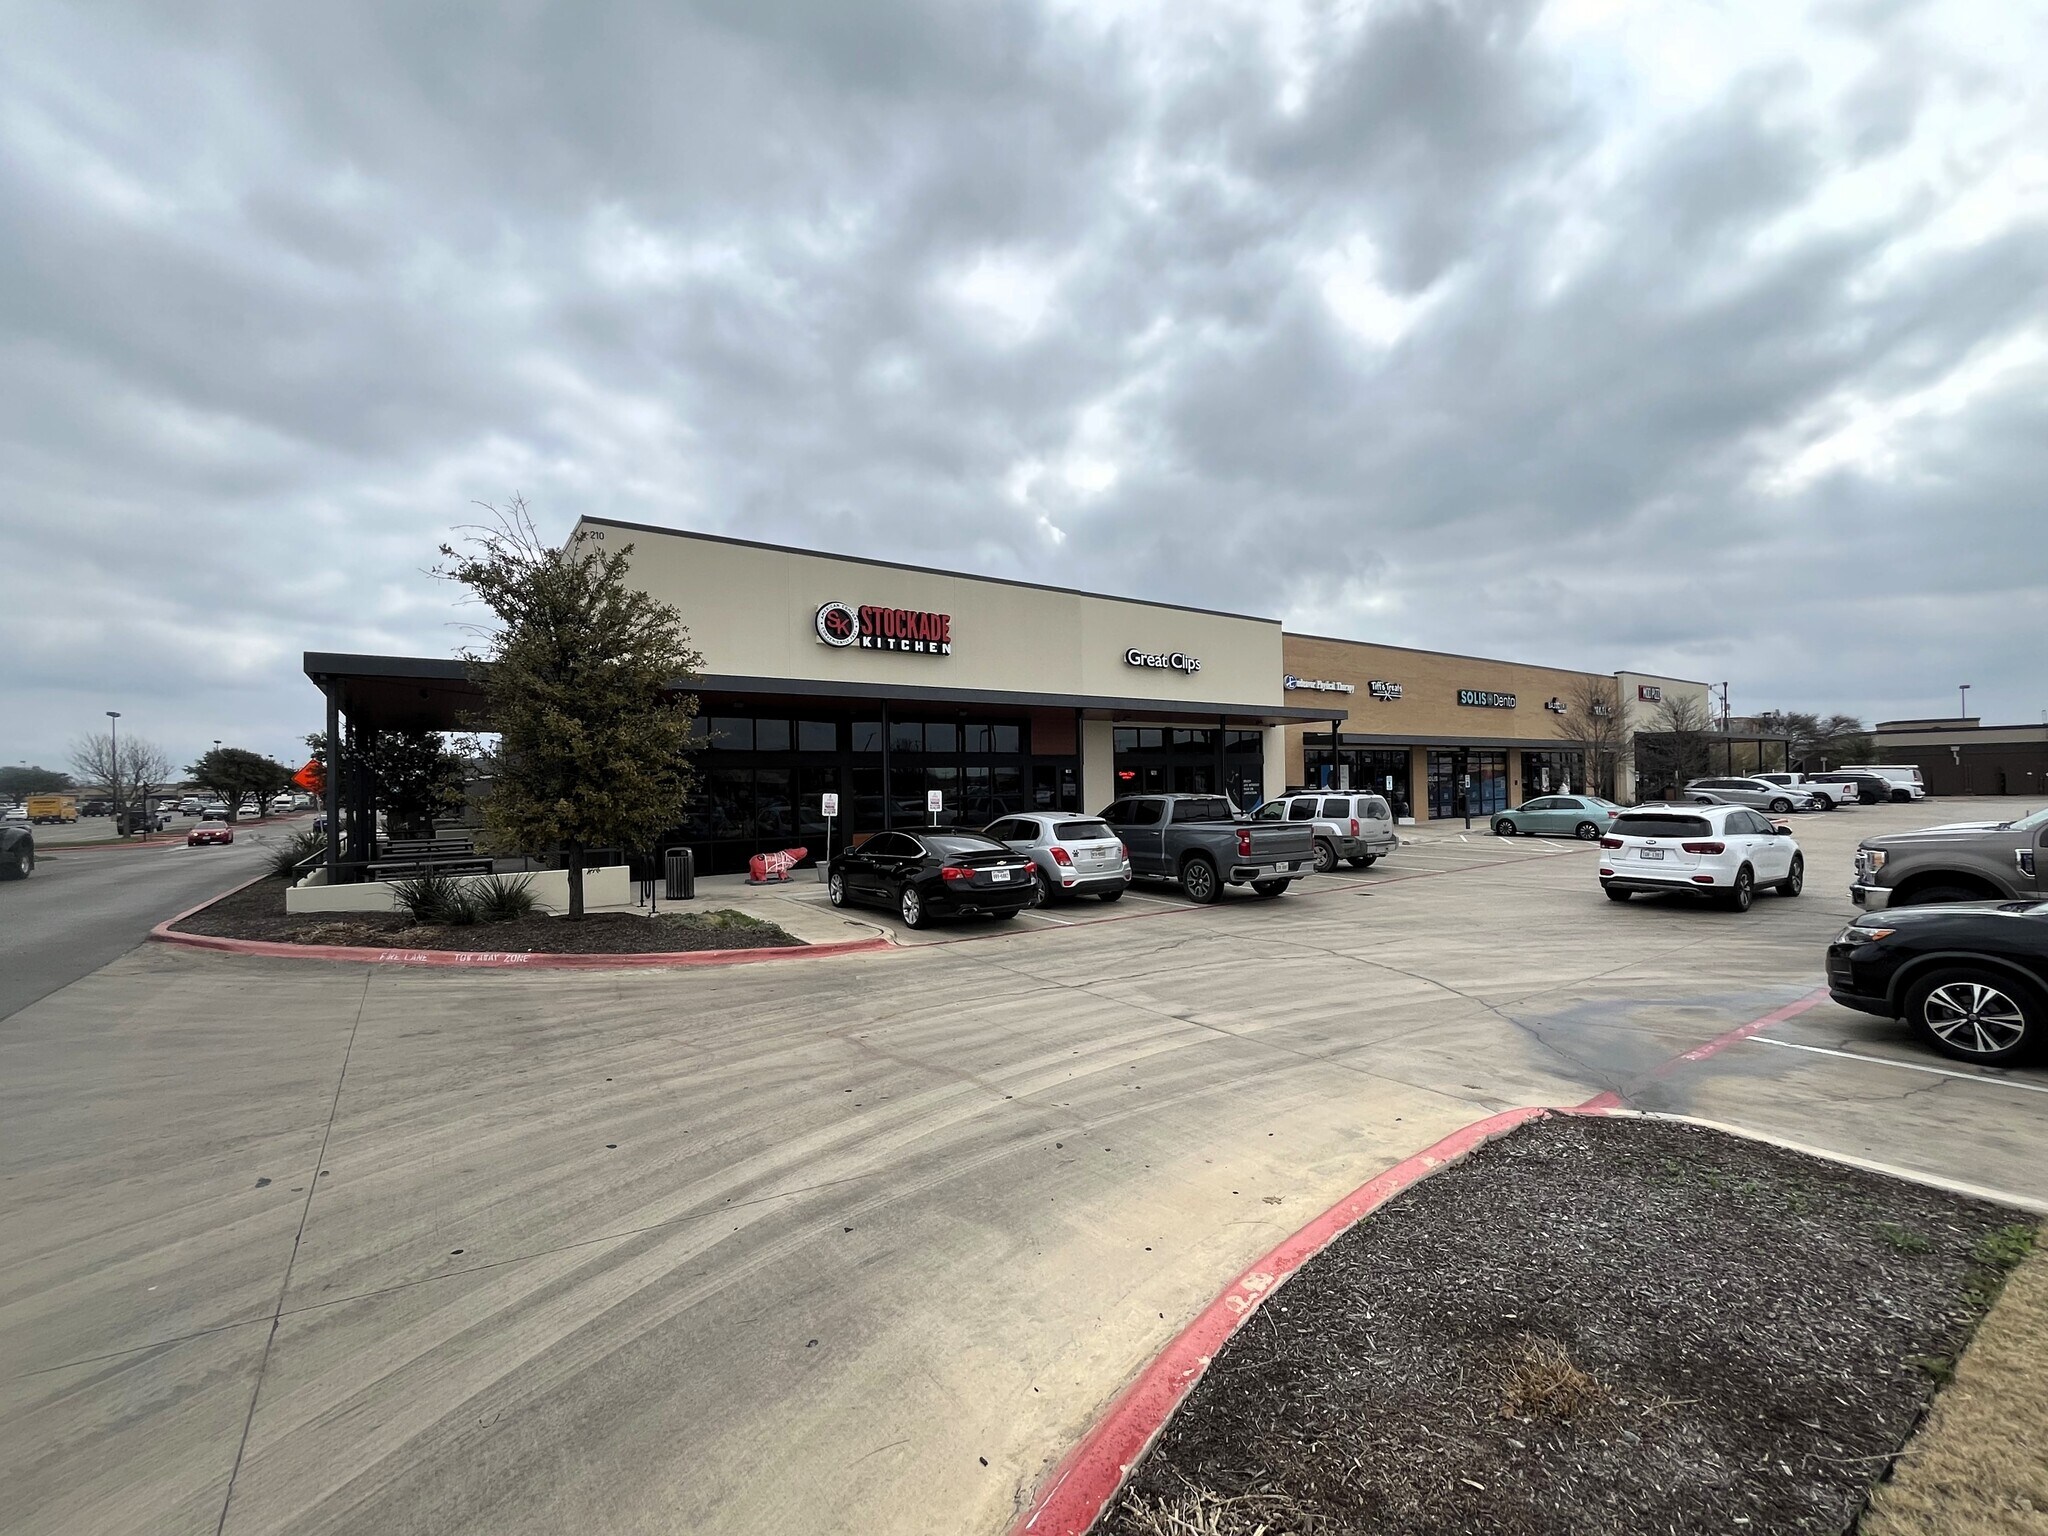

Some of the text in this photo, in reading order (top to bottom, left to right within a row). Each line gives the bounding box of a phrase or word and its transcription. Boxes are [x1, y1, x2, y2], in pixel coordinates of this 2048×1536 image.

[590, 531, 605, 540] 210
[827, 610, 850, 636] SK
[861, 606, 951, 642] STOCKADE
[862, 636, 951, 654] KITCHEN
[1127, 648, 1201, 673] Great Clips
[1461, 690, 1487, 705] SOLIS
[404, 953, 428, 962] LANE
[503, 953, 531, 963] ZONE
